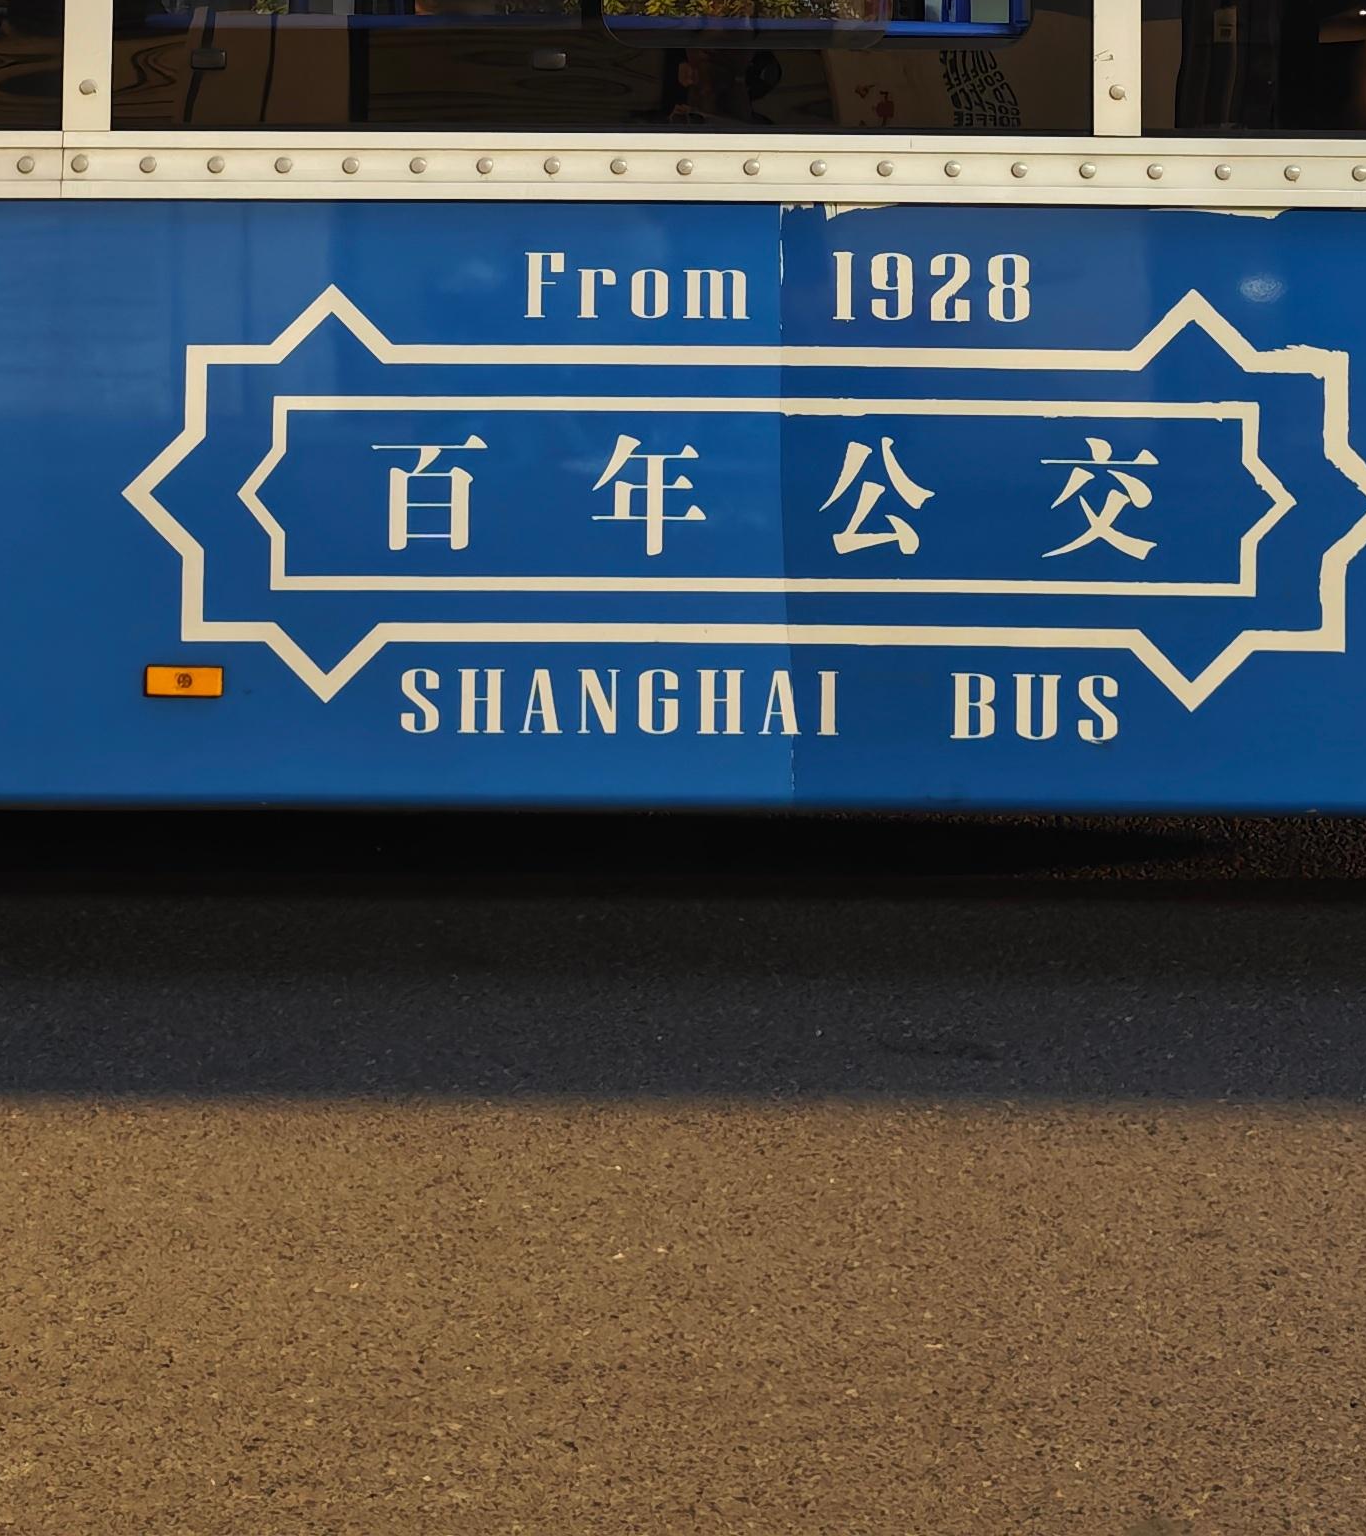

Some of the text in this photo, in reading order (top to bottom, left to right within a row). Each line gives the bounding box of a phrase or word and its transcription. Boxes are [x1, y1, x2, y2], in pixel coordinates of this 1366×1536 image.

[525, 251, 1031, 323] From 1928
[371, 434, 1159, 561] 百年公交
[400, 668, 1118, 741] SHANGHAI BUS
